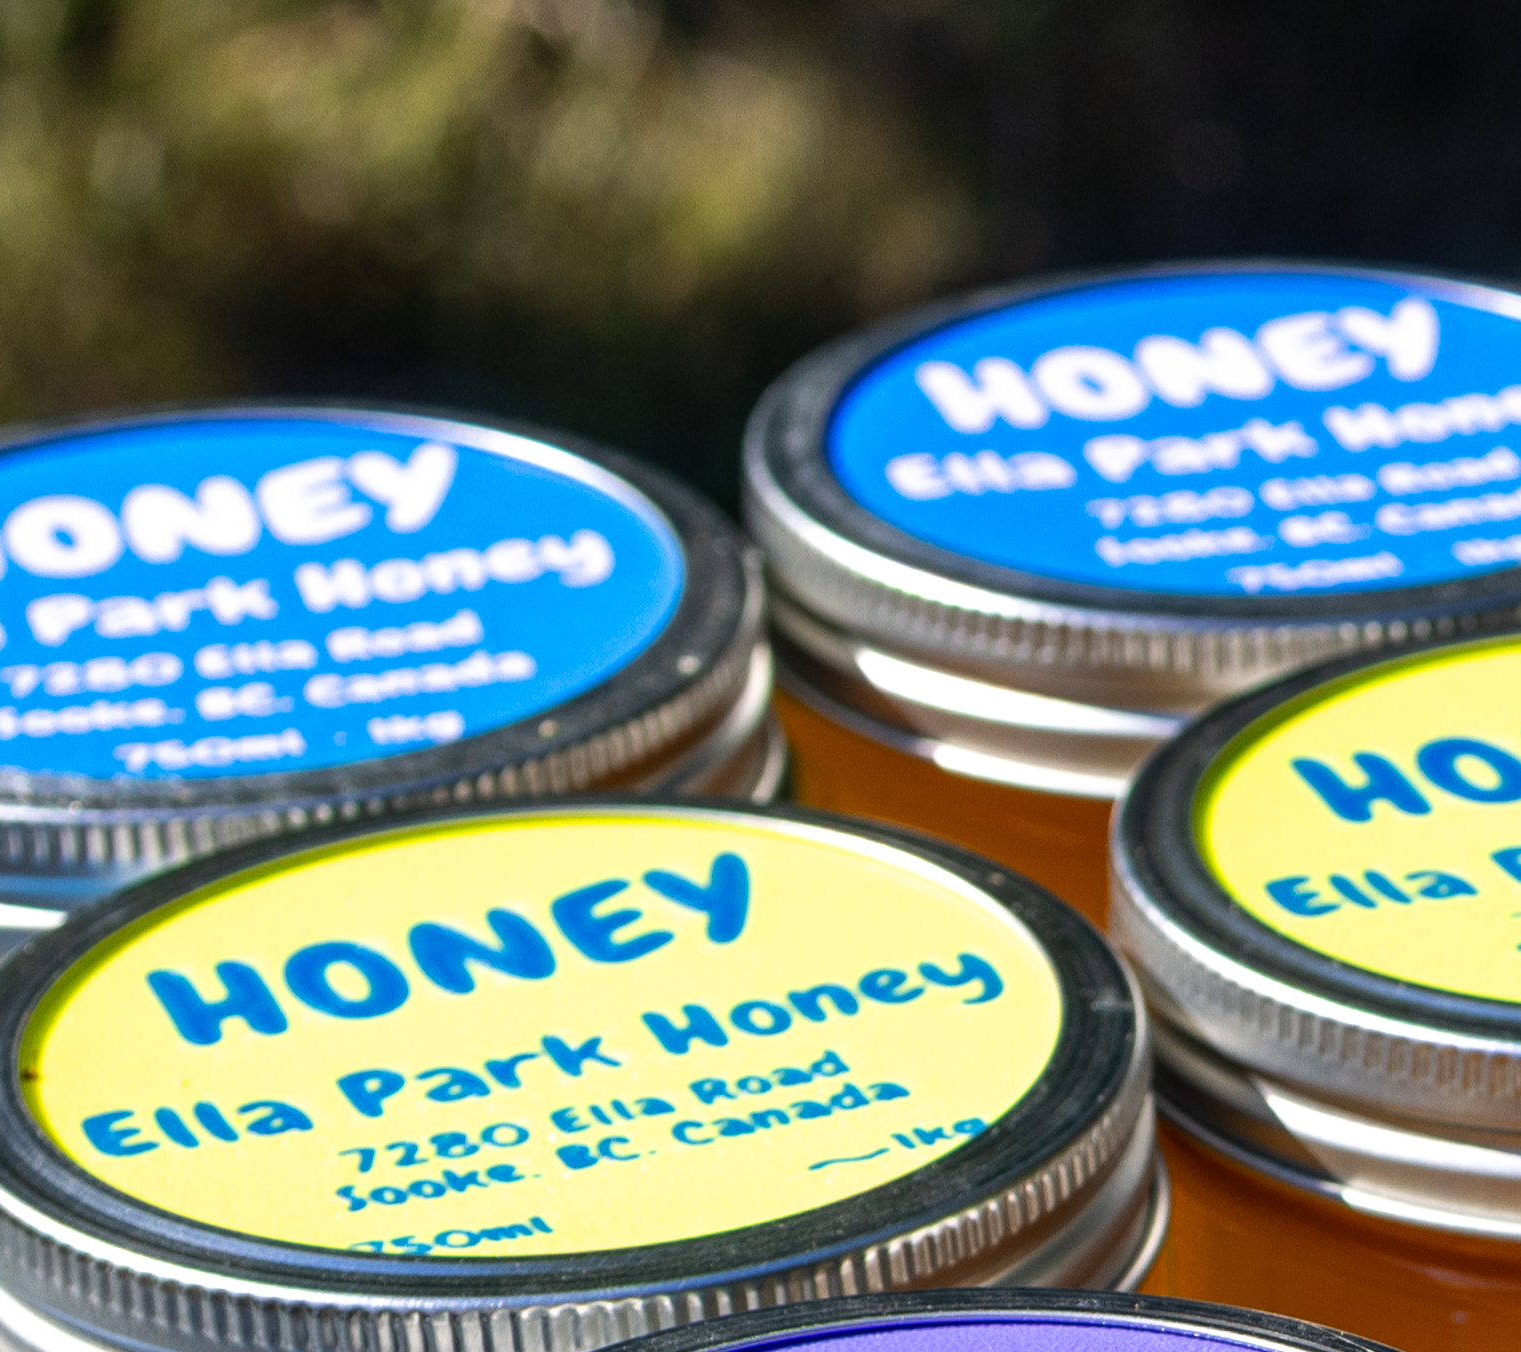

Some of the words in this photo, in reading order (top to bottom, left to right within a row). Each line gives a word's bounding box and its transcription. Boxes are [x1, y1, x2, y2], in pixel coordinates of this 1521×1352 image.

[916, 297, 1440, 434] HONEY
[886, 451, 1075, 499] Ella
[1085, 420, 1316, 481] Park
[24, 576, 279, 648] Park
[294, 528, 615, 612] Honey
[326, 610, 483, 662] Road
[304, 651, 535, 707] Canada
[1266, 871, 1478, 916] Ella
[147, 853, 750, 1046] HONEY
[82, 1101, 313, 1157] Ella
[337, 1036, 621, 1118] Park
[642, 953, 1004, 1055] Honey
[338, 1122, 529, 1174] 7280
[550, 1098, 680, 1143] Ella
[690, 1050, 854, 1105] Road
[671, 1081, 912, 1146] Canada
